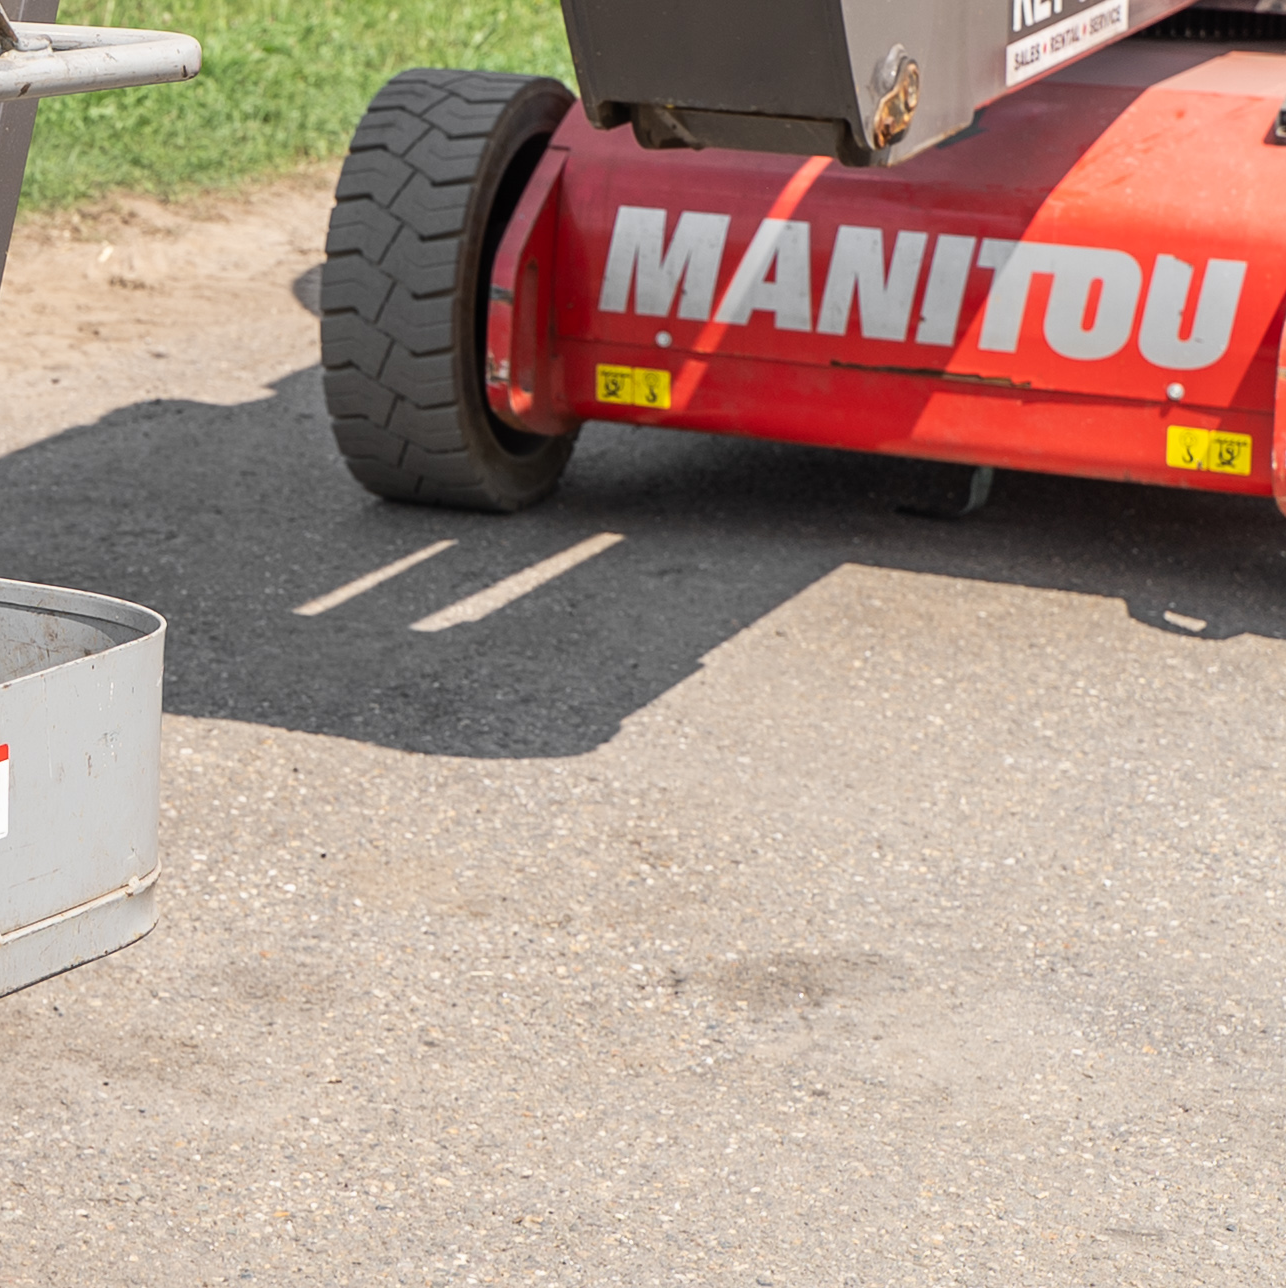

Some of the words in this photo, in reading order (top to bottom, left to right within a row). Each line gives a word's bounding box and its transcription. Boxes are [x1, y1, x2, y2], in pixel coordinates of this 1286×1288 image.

[1014, 42, 1040, 71] SALES
[1050, 24, 1080, 53] RENTAL
[1089, 5, 1121, 35] SERVICE
[598, 205, 1248, 370] MANITOU
